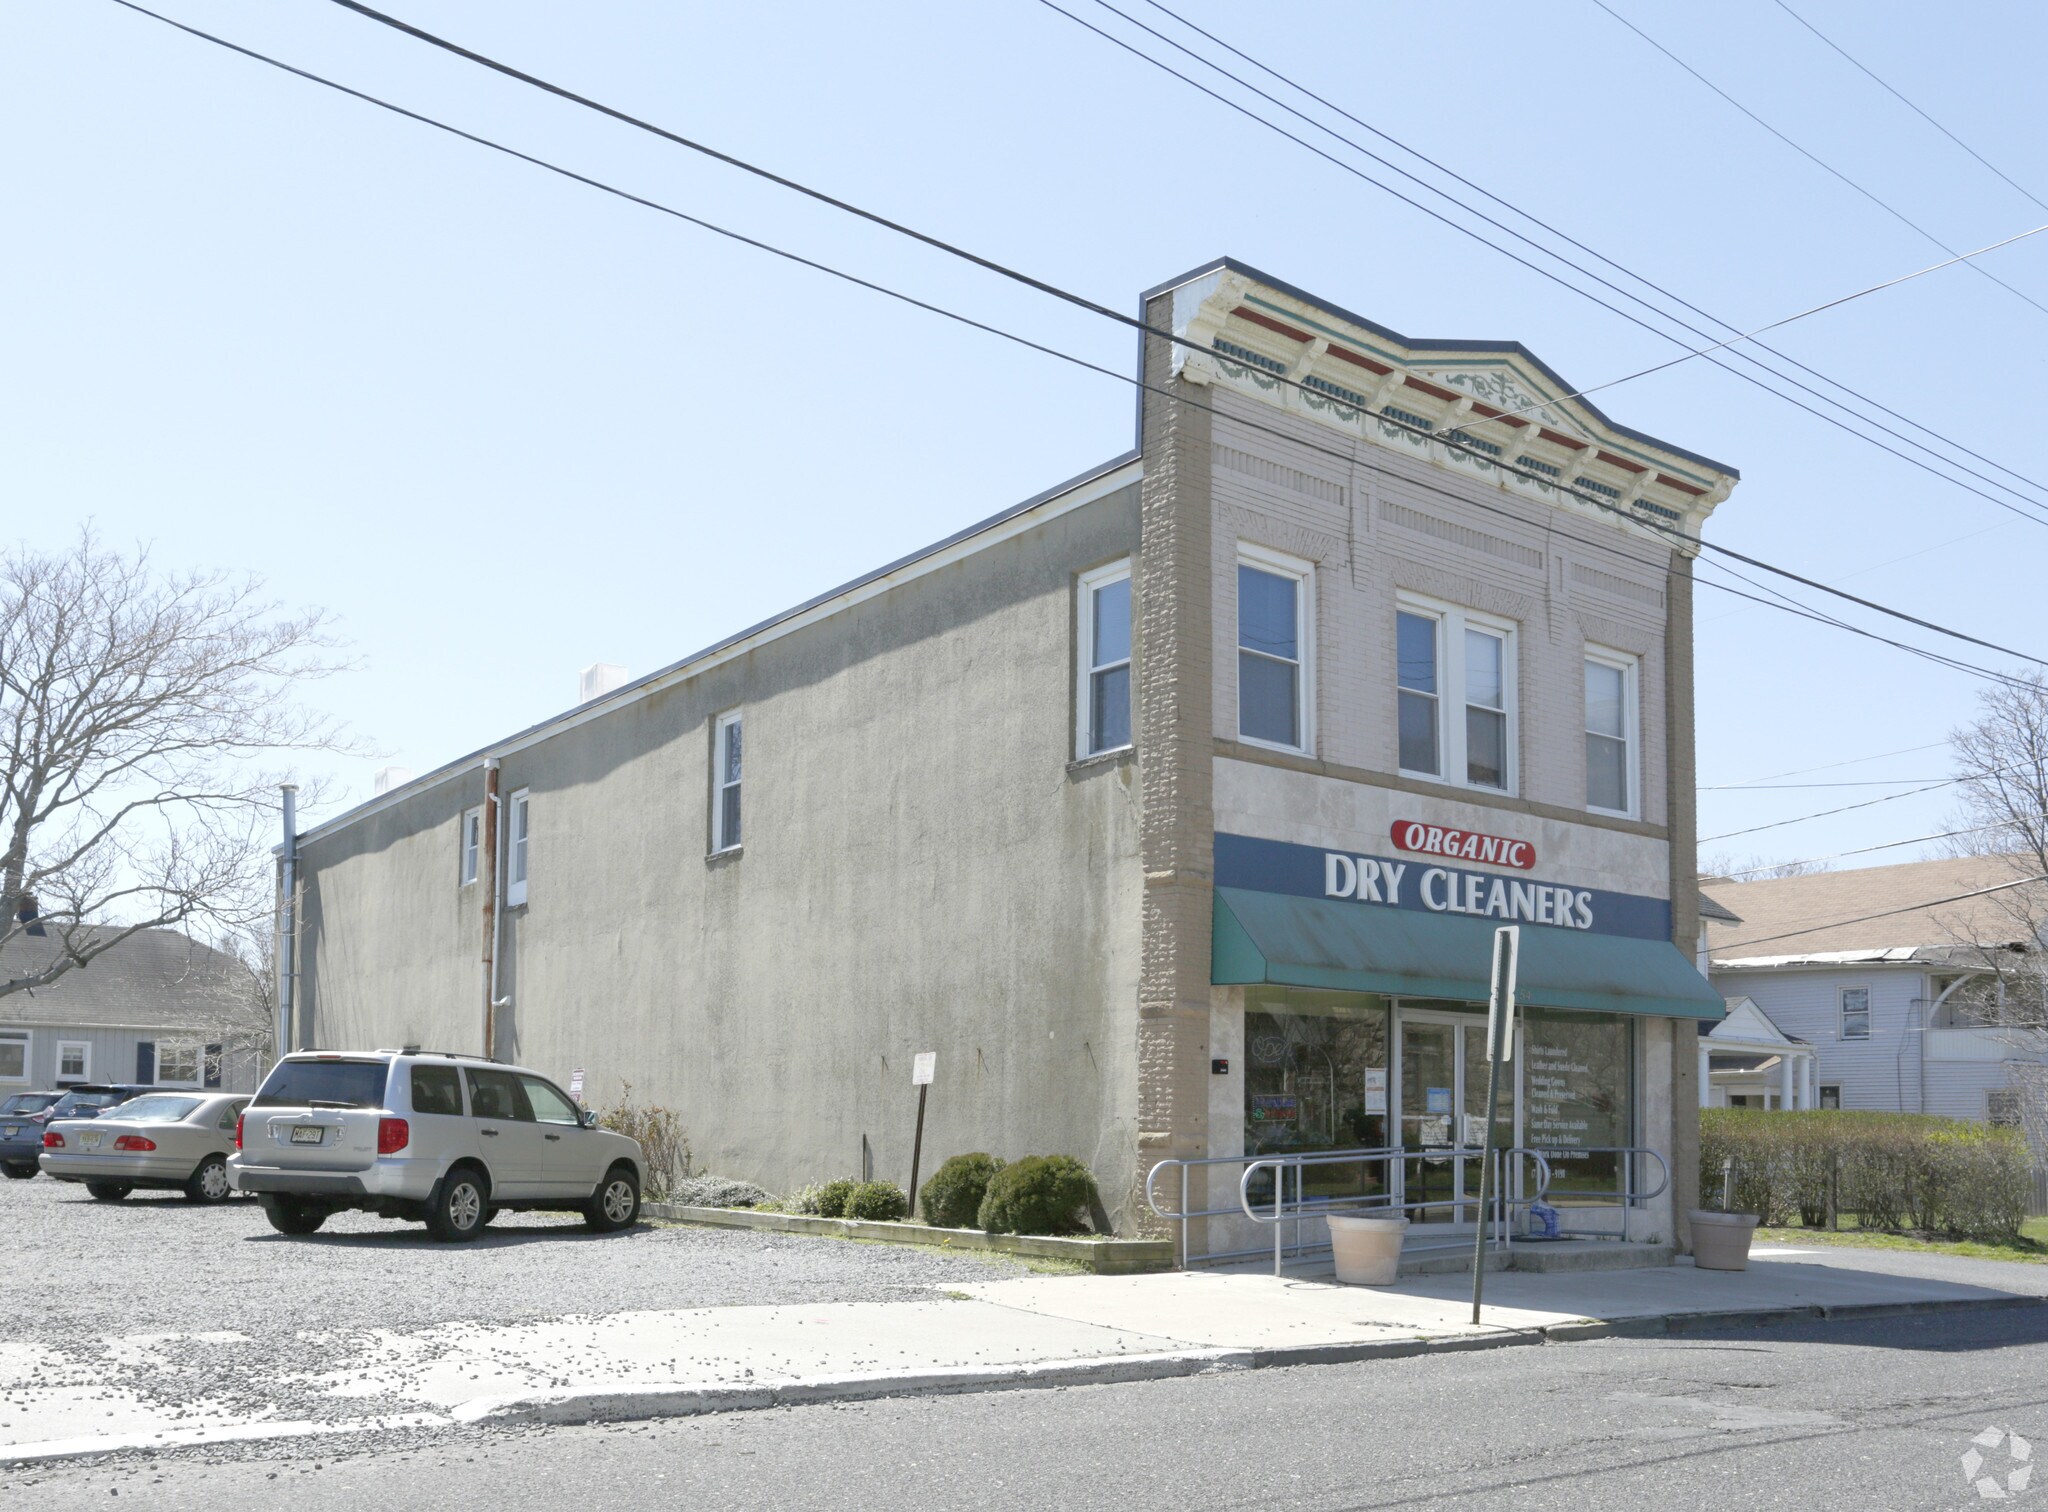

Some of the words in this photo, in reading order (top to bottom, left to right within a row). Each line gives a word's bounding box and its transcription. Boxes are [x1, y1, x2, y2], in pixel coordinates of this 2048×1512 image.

[1405, 824, 1526, 867] ORGANIC
[1325, 853, 1406, 904] DRY
[1420, 868, 1593, 930] CLEANERS
[1531, 1059, 1548, 1070] Leather
[1548, 1060, 1557, 1070] and
[1558, 1060, 1570, 1071] Suede
[1570, 1062, 1589, 1073] Cleaned
[1531, 1075, 1550, 1087] Wedding
[1531, 1087, 1550, 1098] Cleaned
[1531, 1103, 1543, 1114] Wash
[1548, 1104, 1559, 1114] Fold
[1531, 1119, 1543, 1129] Same
[1543, 1119, 1552, 1132] Day
[1553, 1120, 1568, 1130] Service
[1569, 1120, 1588, 1130] Available
[1531, 1133, 1541, 1144] Free
[1541, 1134, 1551, 1144] Pick
[1552, 1137, 1558, 1146] up
[1563, 1134, 1581, 1147] Delivery
[1550, 1150, 1562, 1159] Done
[1570, 1150, 1590, 1159] Premises
